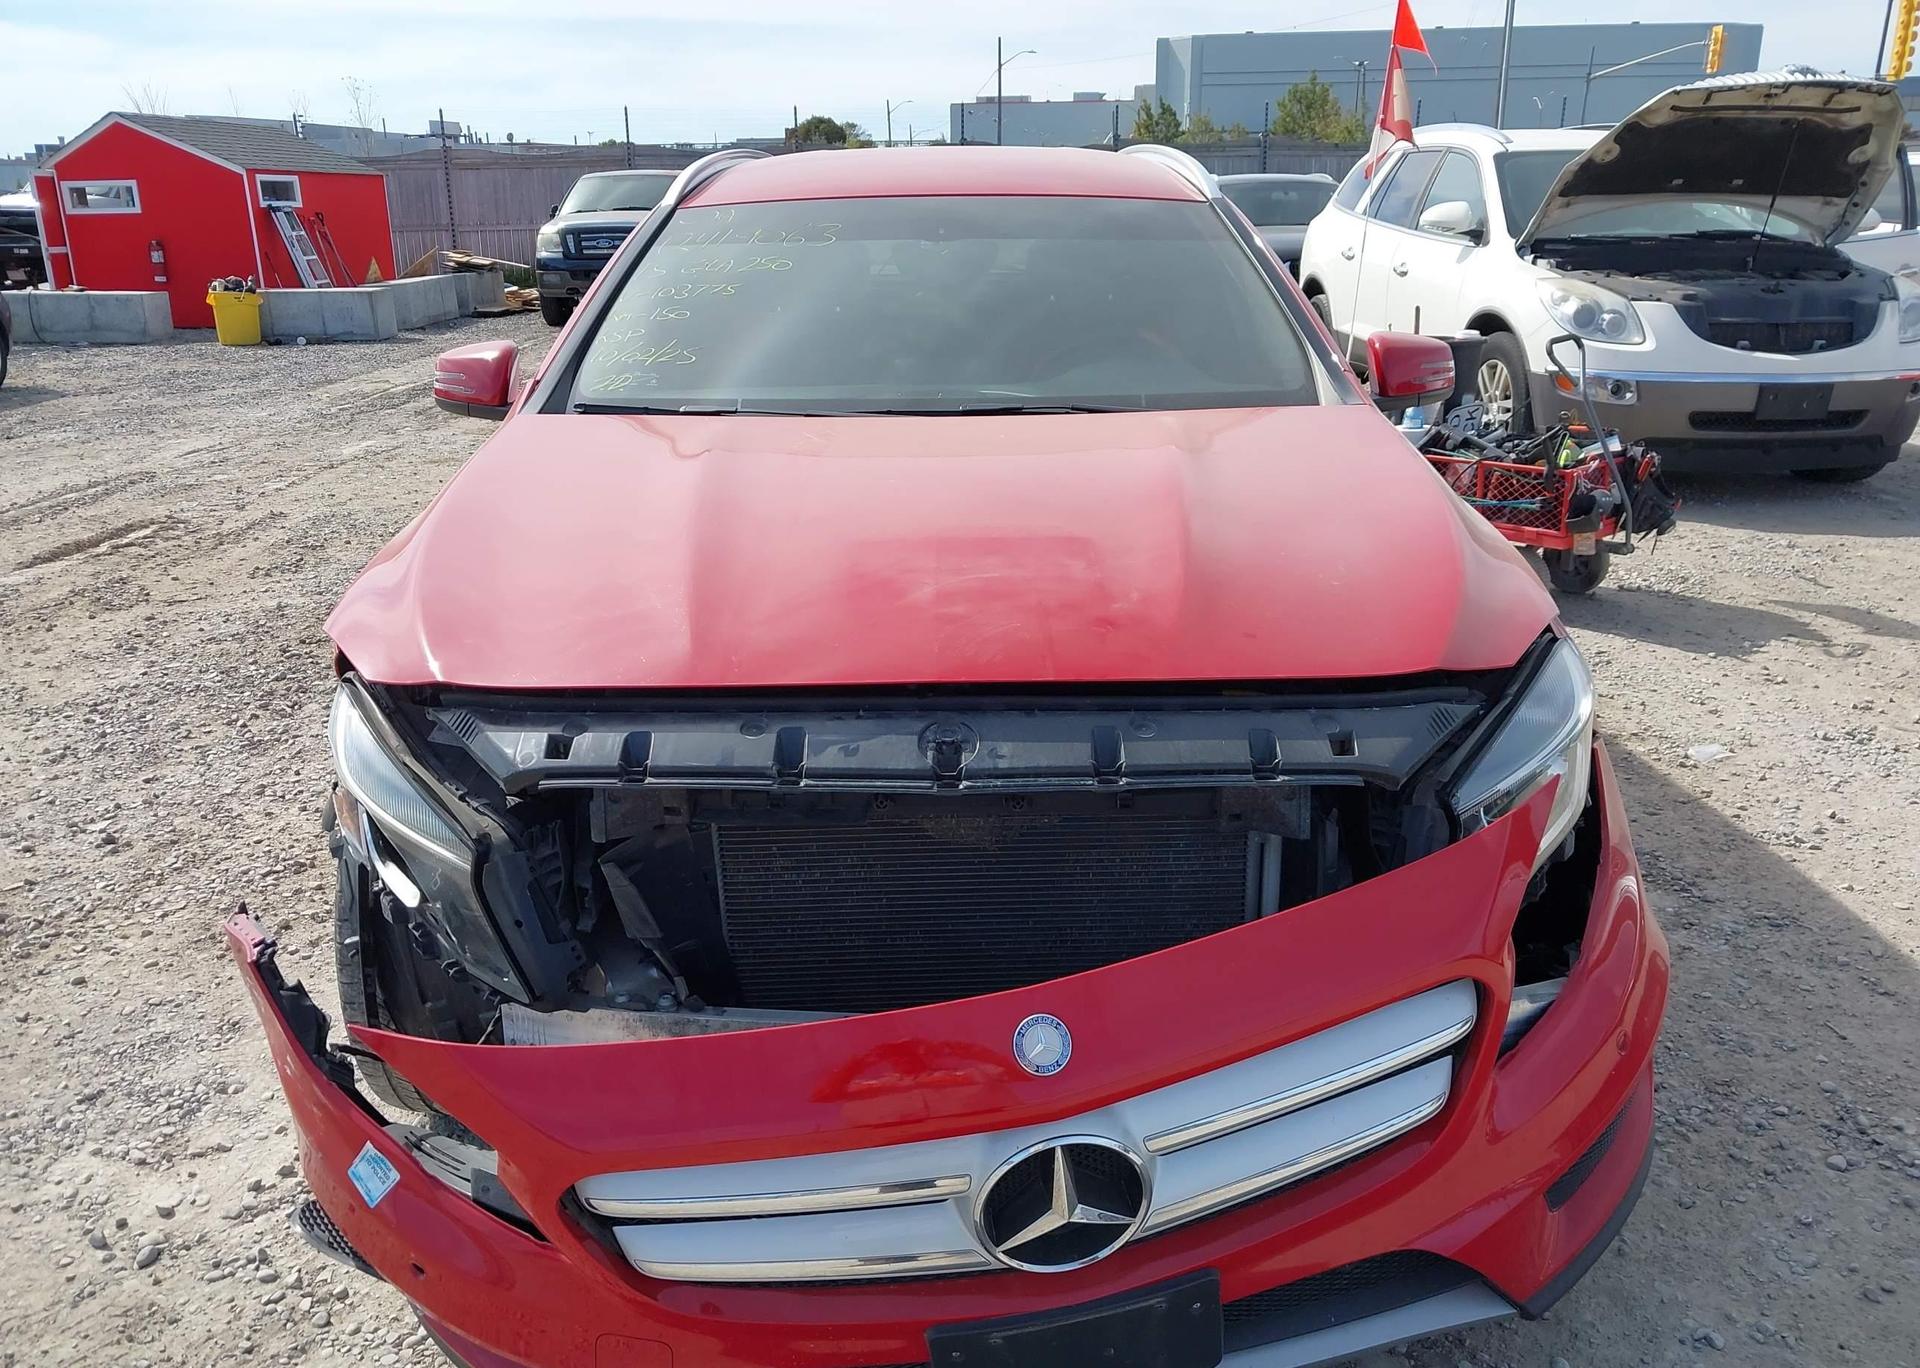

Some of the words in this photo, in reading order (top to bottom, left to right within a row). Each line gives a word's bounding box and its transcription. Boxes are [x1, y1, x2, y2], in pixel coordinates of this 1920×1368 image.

[737, 255, 793, 272] 250
[1020, 1016, 1058, 1034] MERCEDES
[1038, 1063, 1060, 1073] BENZ
[365, 1157, 372, 1167] TO
[370, 1165, 387, 1186] POLICE
